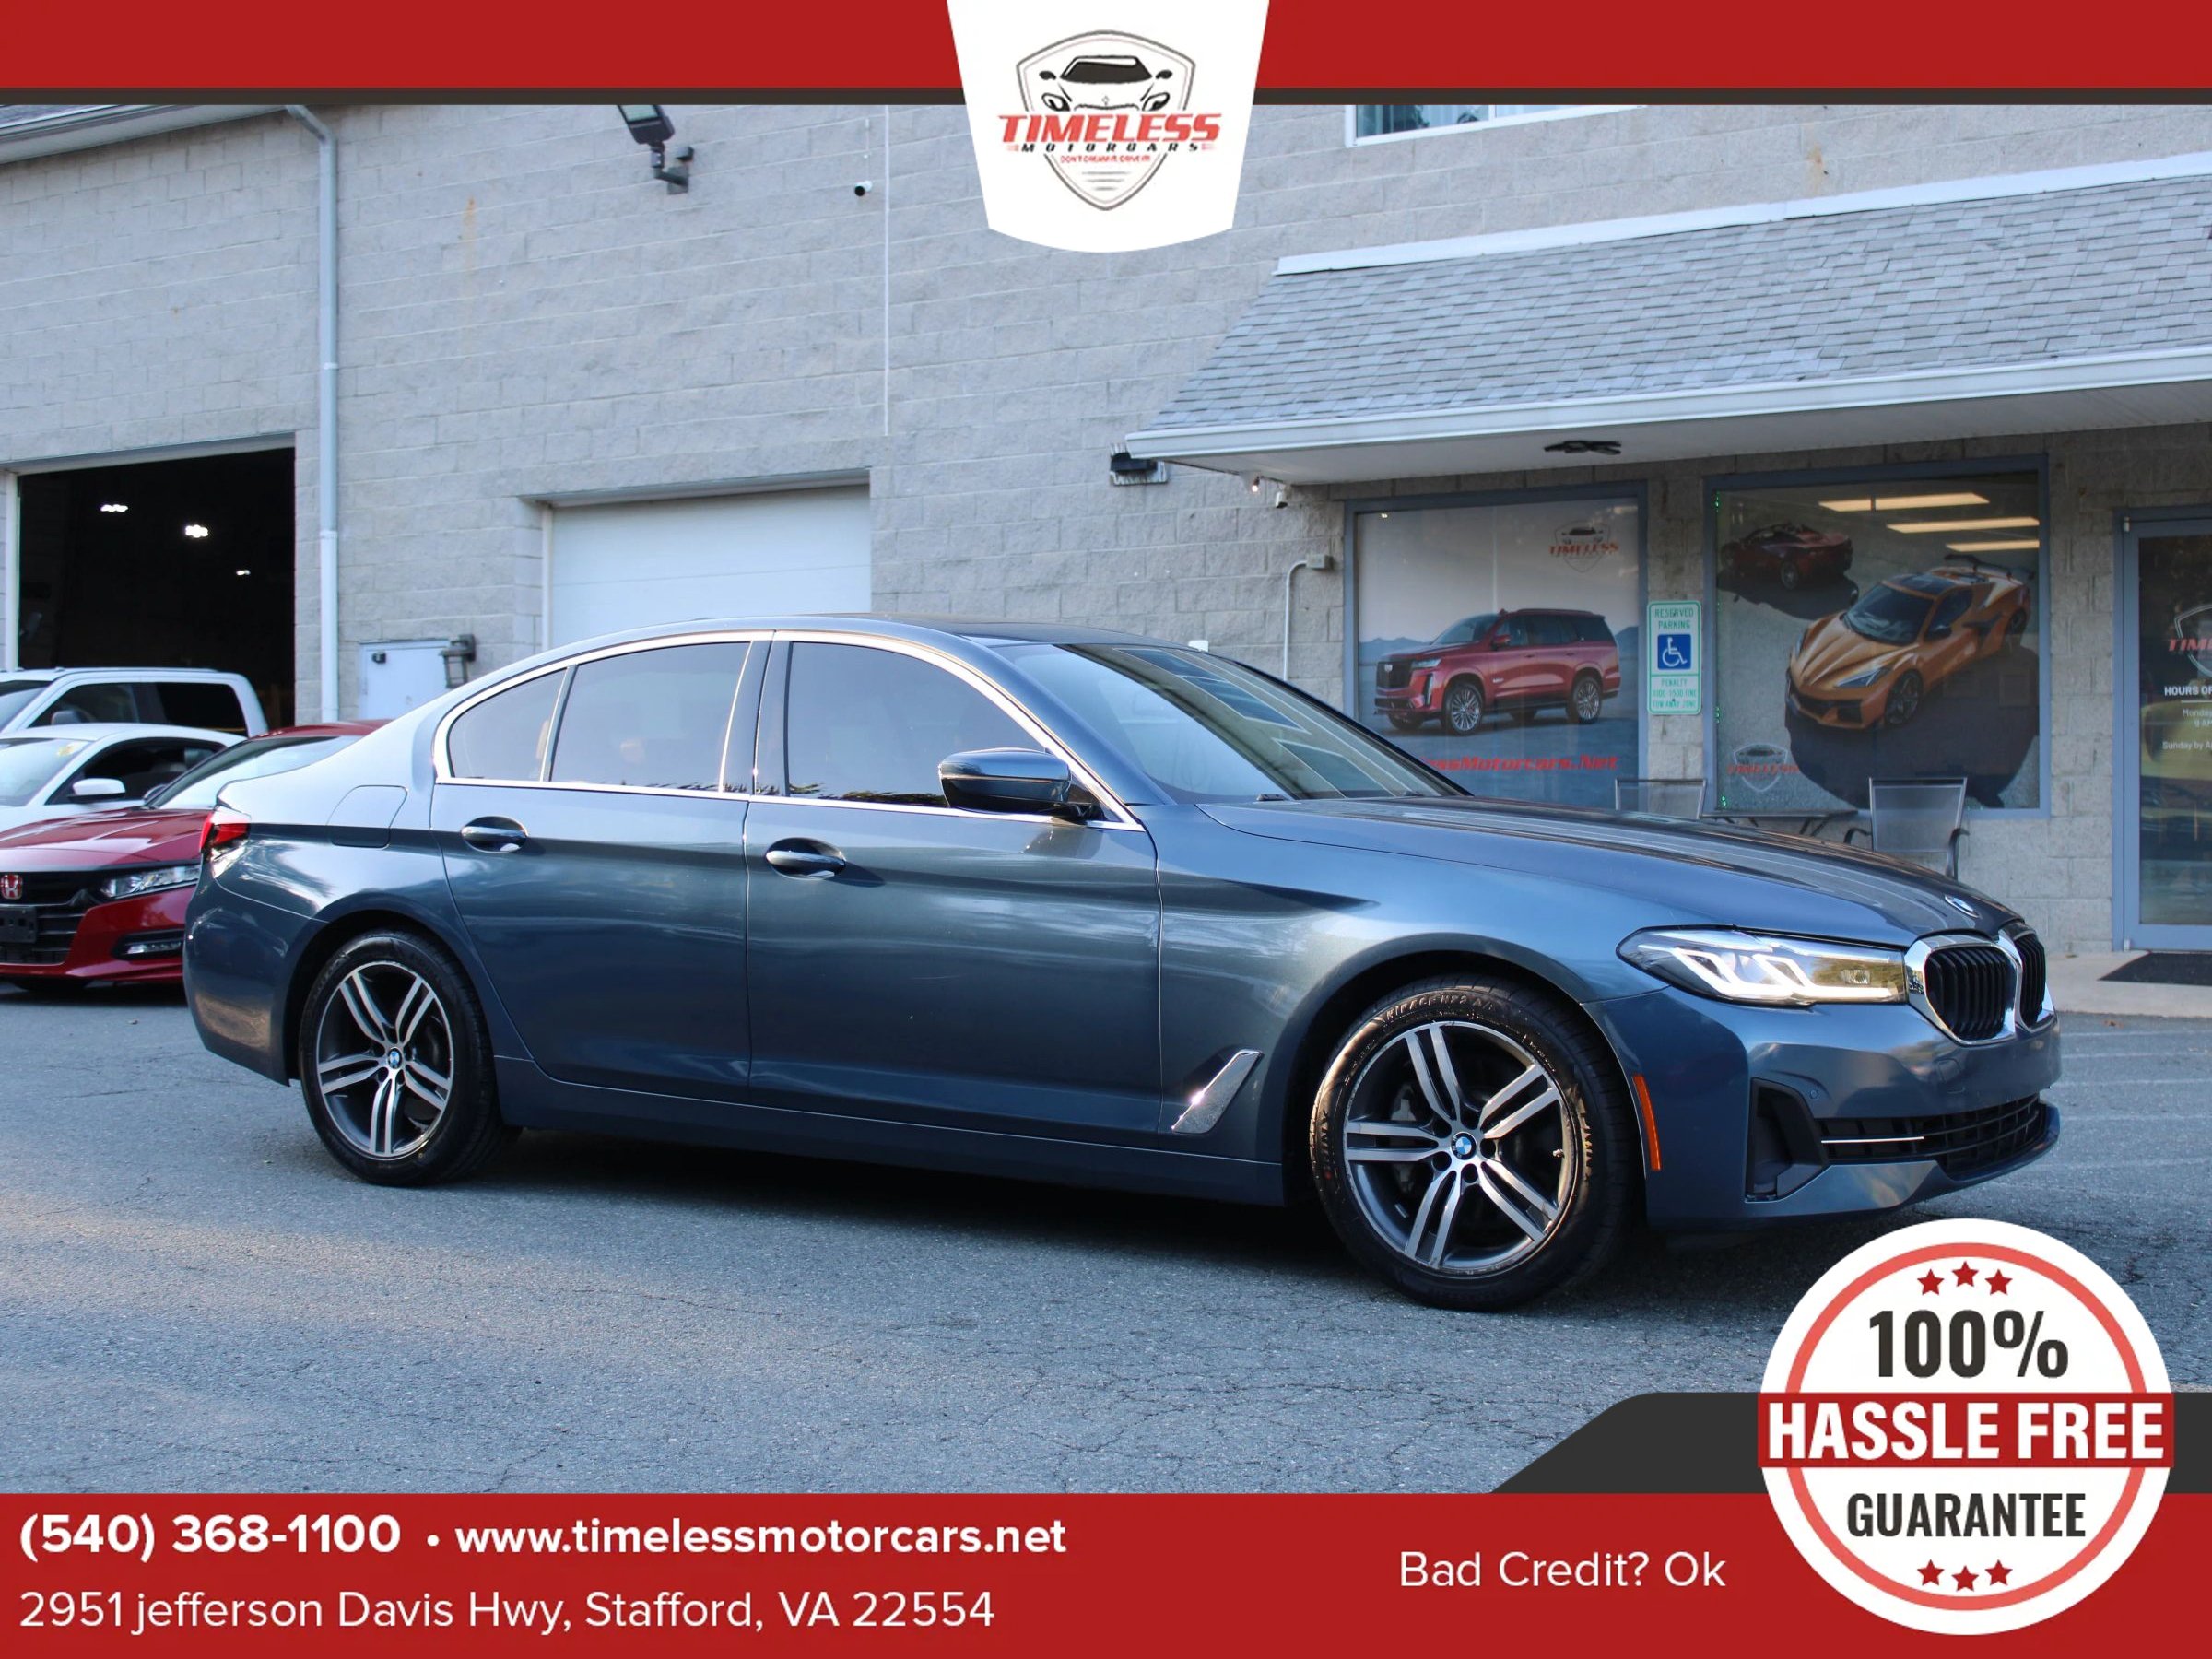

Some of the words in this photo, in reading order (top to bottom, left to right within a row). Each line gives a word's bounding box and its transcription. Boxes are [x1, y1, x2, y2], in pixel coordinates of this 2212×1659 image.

[1654, 607, 1694, 618] RESERVED
[1658, 619, 1691, 629] PARKING
[2164, 686, 2199, 697] HOURS
